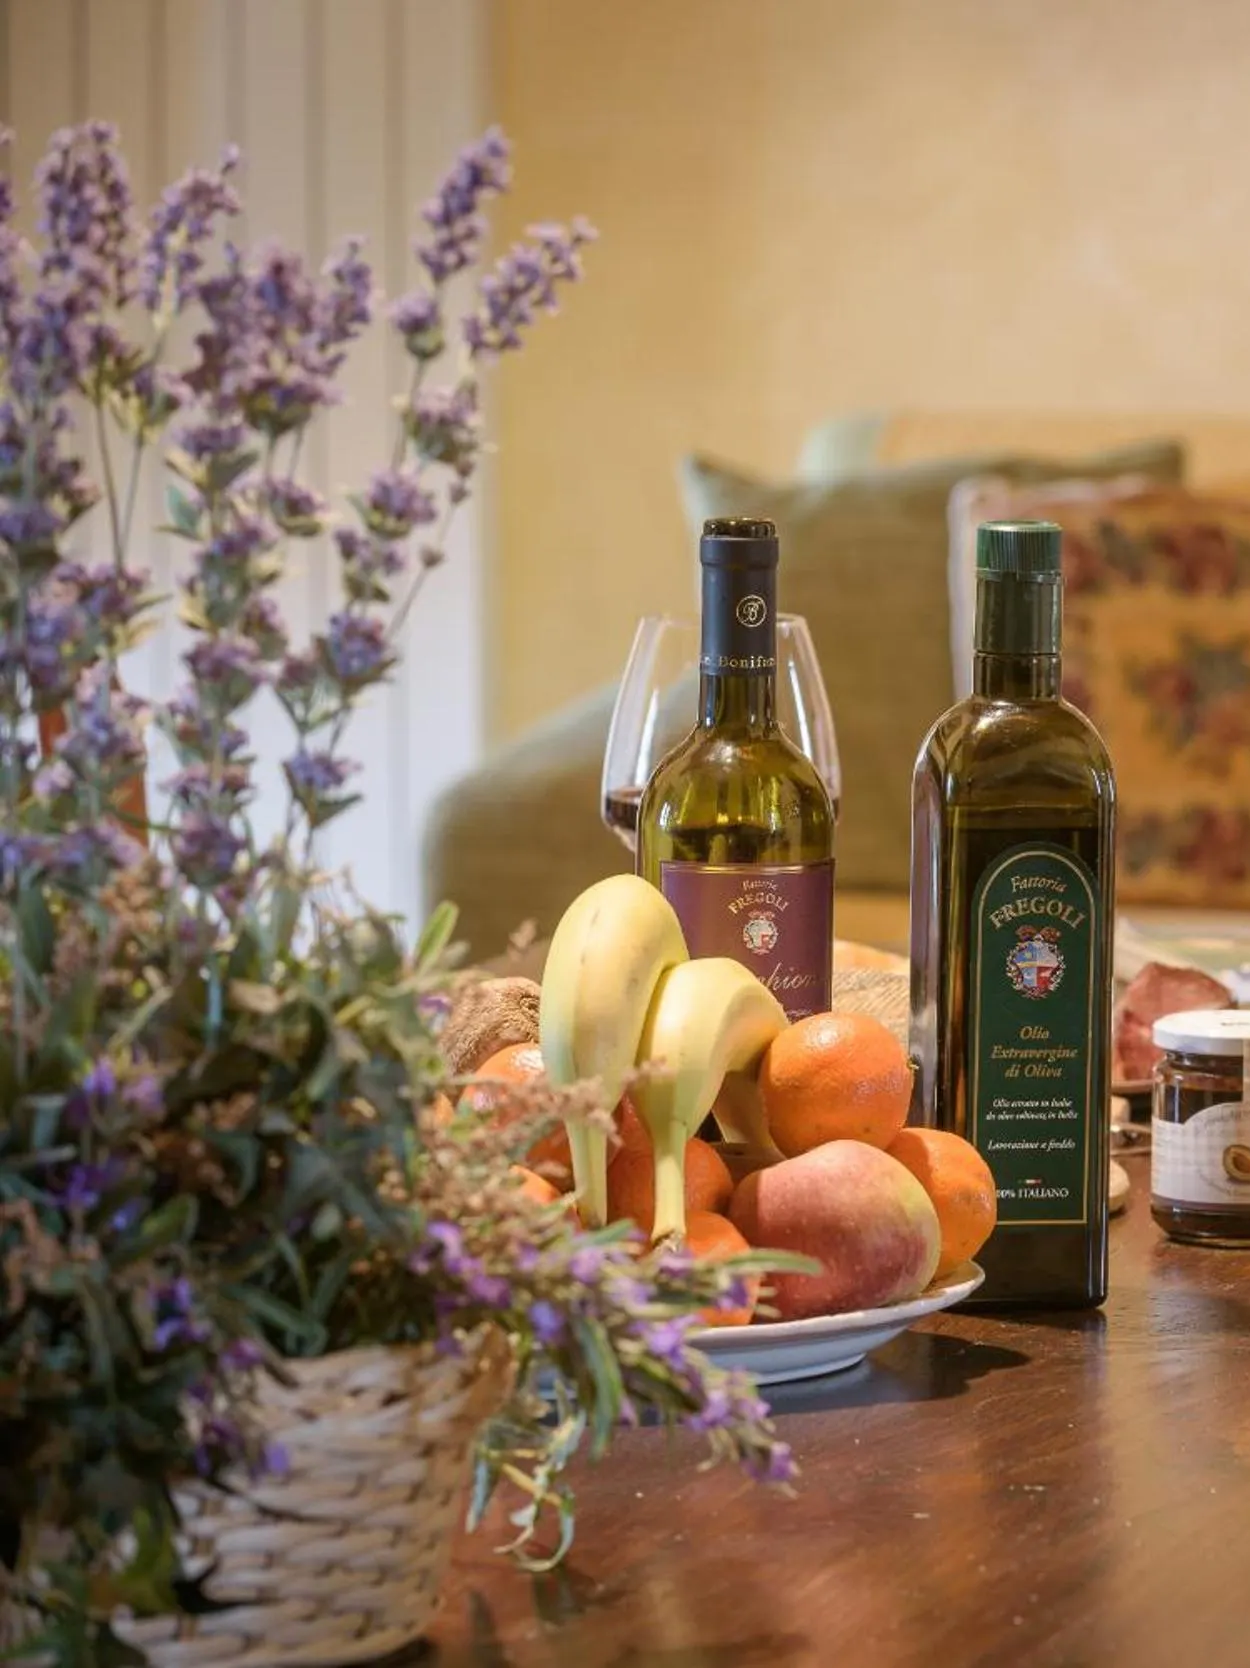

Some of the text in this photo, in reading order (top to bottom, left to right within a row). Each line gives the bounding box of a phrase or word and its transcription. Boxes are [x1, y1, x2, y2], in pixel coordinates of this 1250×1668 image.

[1010, 876, 1068, 893] Fattoria
[728, 892, 790, 914] FREGOLI
[989, 897, 1086, 930] FREGOLI
[1019, 1026, 1050, 1039] Olio
[990, 1044, 1078, 1062] Extravergine
[1004, 1064, 1063, 1078] di Oliva
[996, 1187, 1069, 1199] 00% ITALIANO
